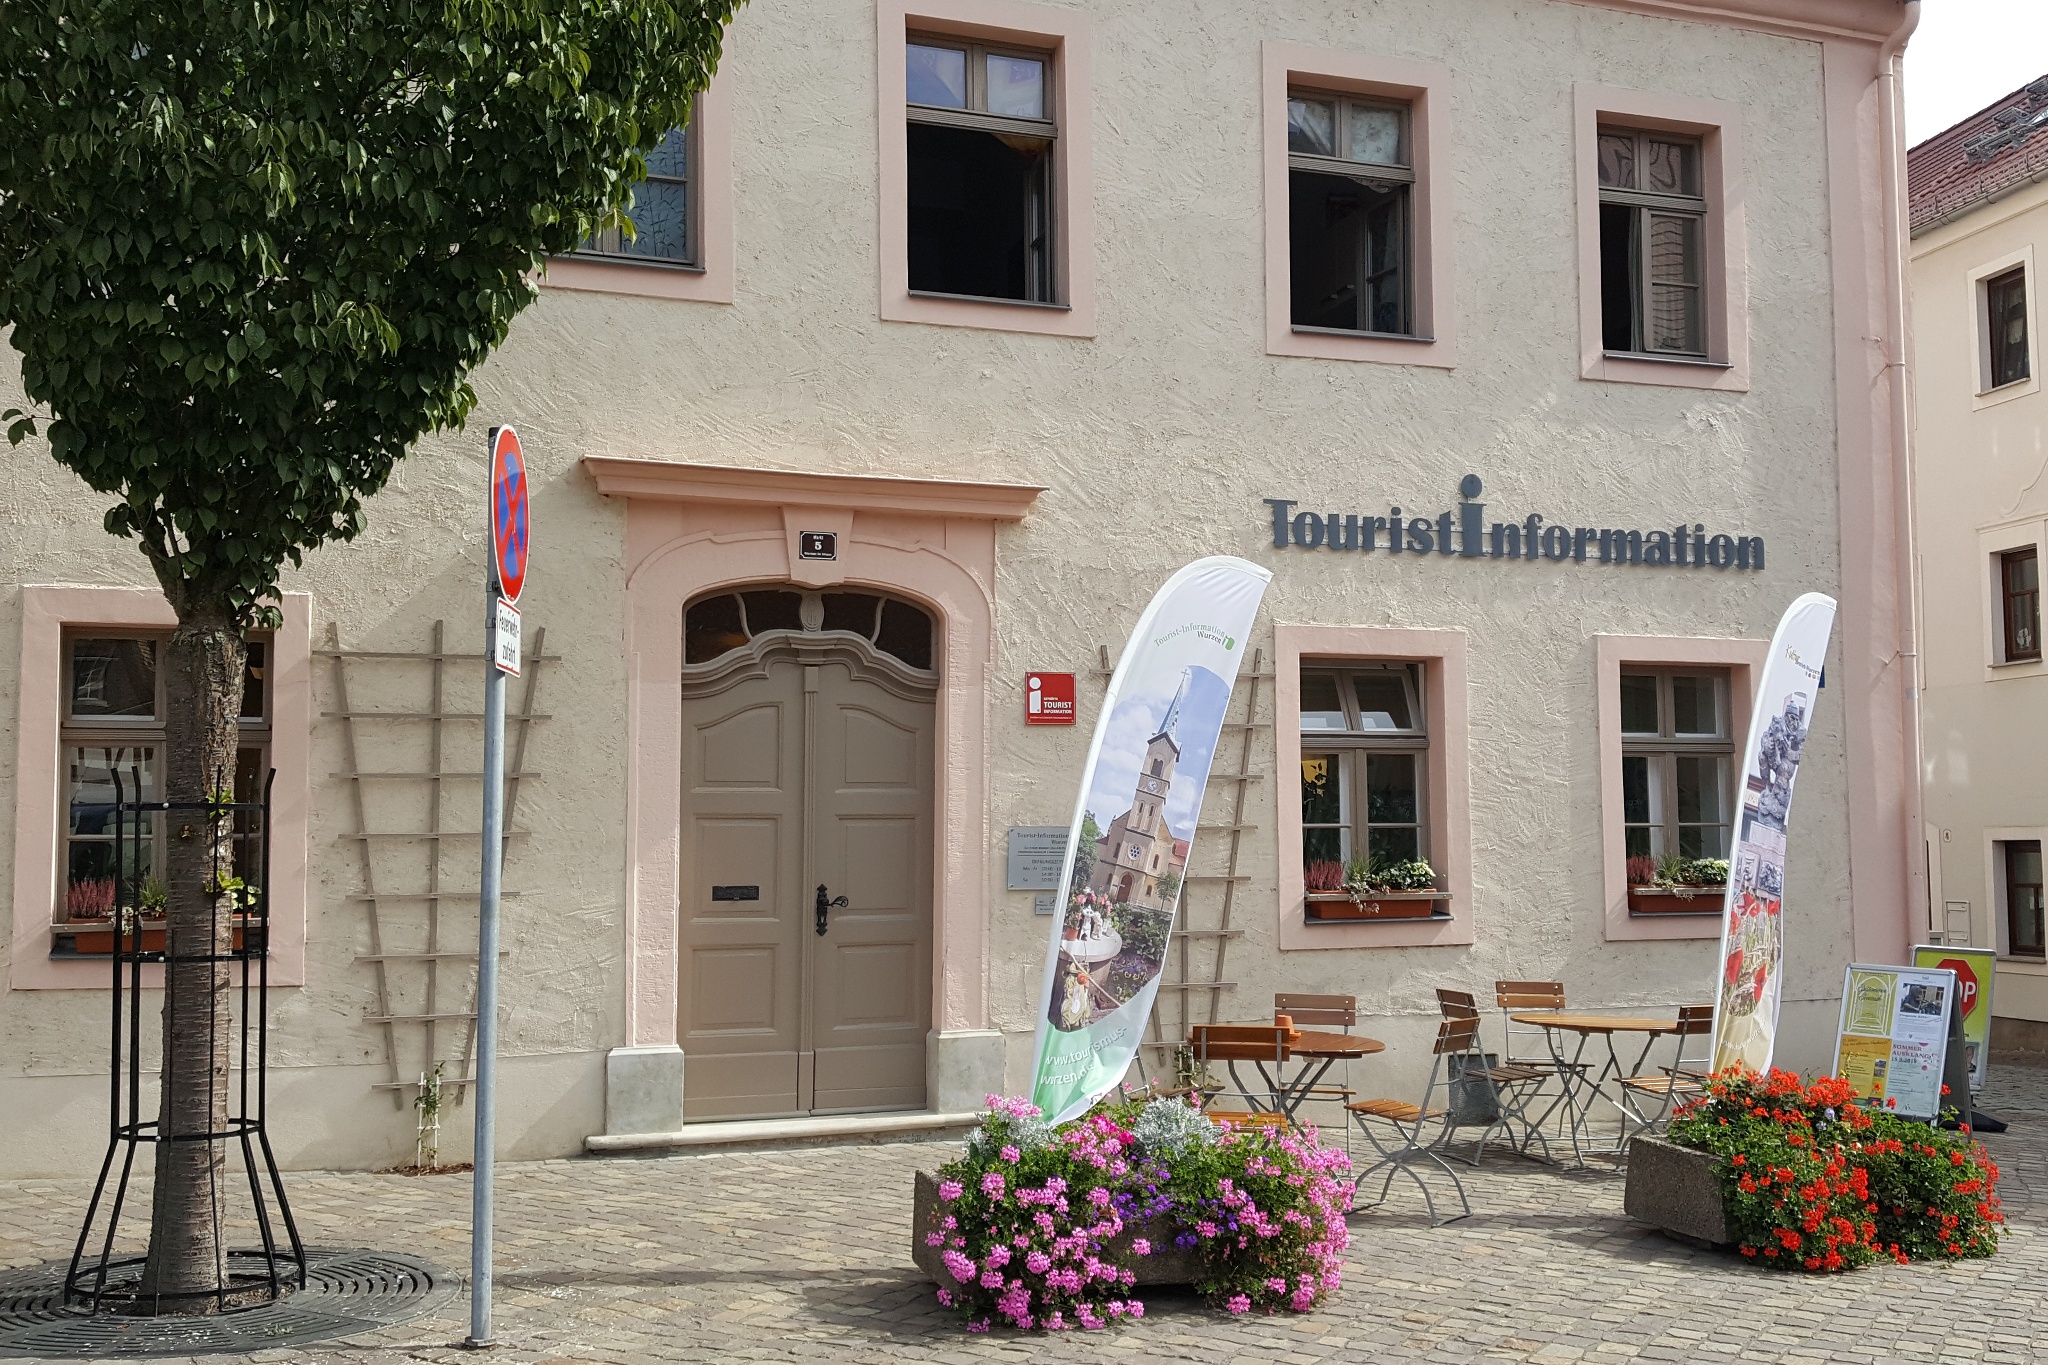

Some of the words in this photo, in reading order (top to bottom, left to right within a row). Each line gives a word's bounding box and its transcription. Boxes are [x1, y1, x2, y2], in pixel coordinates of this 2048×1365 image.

[814, 541, 822, 551] 5
[499, 609, 520, 639] Feuerwehr-
[1154, 623, 1224, 646] Tourist-Information
[502, 641, 516, 665] zufahrt
[1043, 701, 1073, 709] TOURIST
[1893, 1044, 1922, 1052] SOMMER
[1892, 1050, 1932, 1059] AUSKLANG
